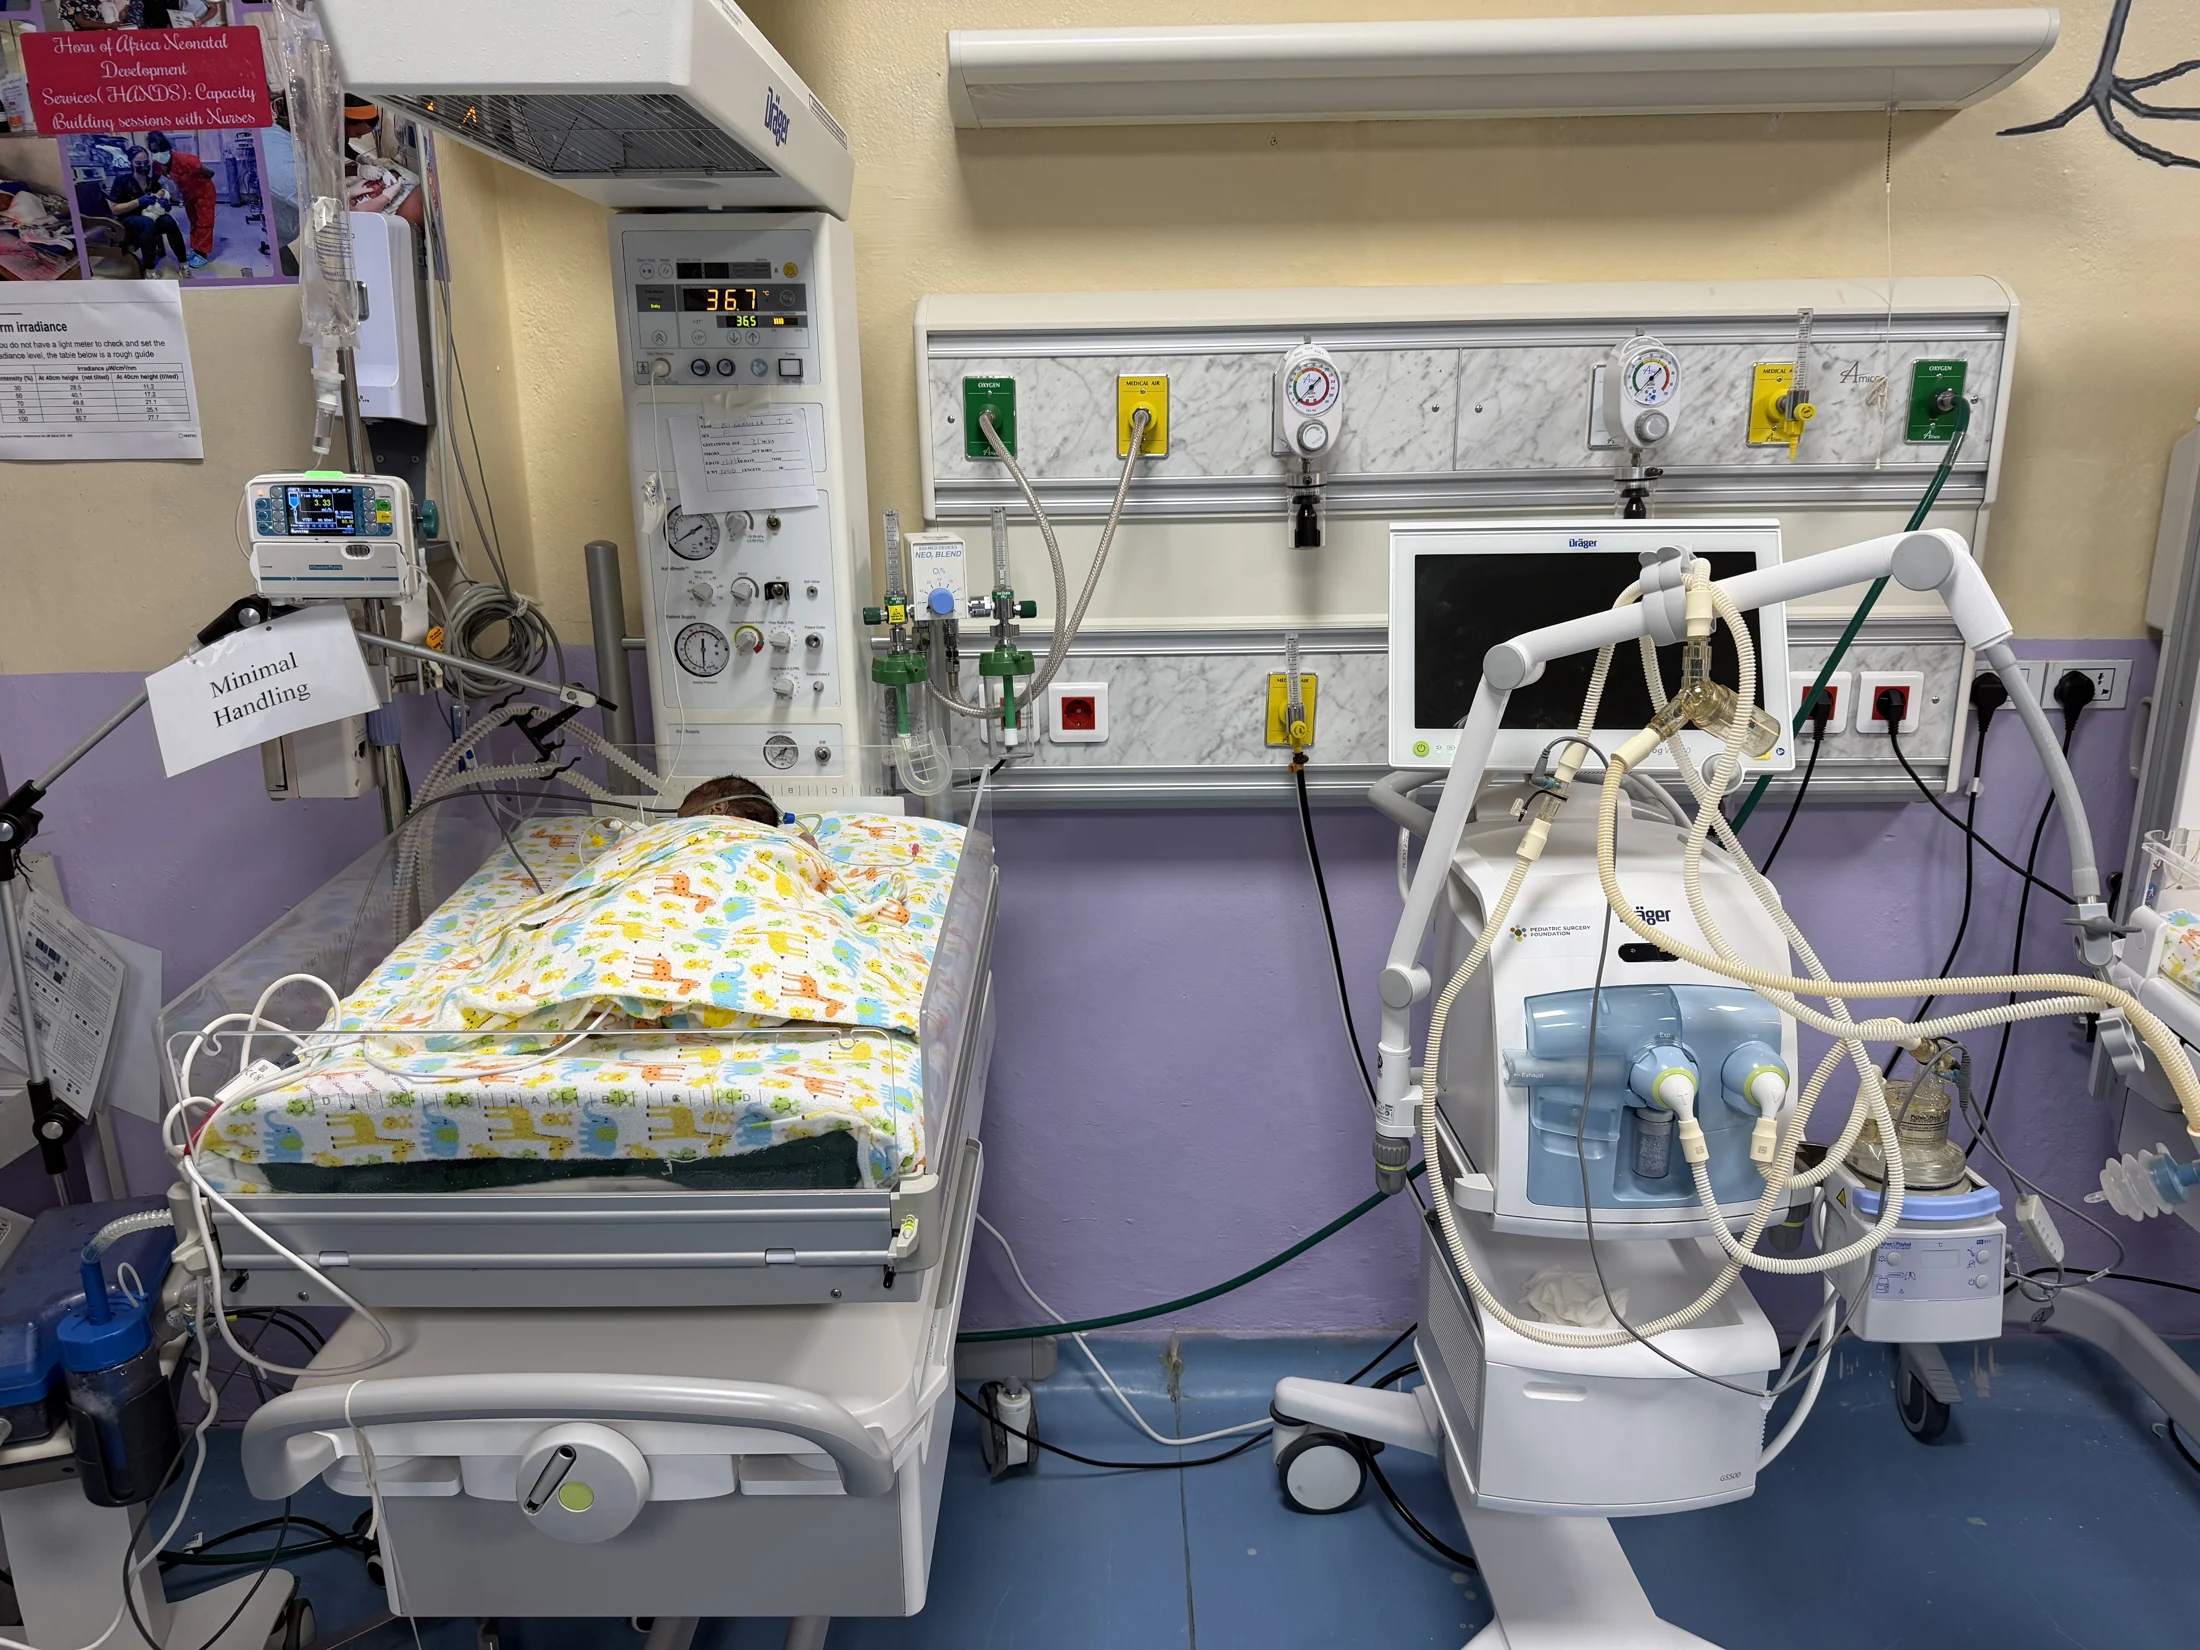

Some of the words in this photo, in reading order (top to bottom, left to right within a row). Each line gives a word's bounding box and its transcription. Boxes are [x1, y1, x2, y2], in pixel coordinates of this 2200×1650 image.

[53, 37, 94, 54] Horn
[100, 38, 111, 56] of
[116, 35, 160, 56] Africa
[164, 33, 228, 51] Neonatal
[100, 60, 188, 80] Development
[195, 83, 256, 104] Capacity
[53, 113, 114, 132] Building
[119, 115, 171, 129] sessions
[175, 110, 204, 126] with
[207, 108, 255, 126] Nurses
[764, 86, 790, 147] Dräger
[707, 289, 756, 311] 36.7
[16, 321, 67, 332] irradiance
[736, 315, 757, 328] 36.5
[9, 341, 19, 349] do
[21, 341, 32, 349] not
[33, 340, 50, 349] have
[58, 340, 73, 350] light
[95, 340, 102, 348] to
[125, 339, 139, 347] and
[153, 339, 165, 347] the
[47, 351, 58, 359] the
[59, 351, 76, 359] table
[78, 350, 97, 359] below
[99, 350, 105, 358] is
[113, 350, 133, 359] rough
[134, 350, 154, 359] guide
[1568, 538, 1598, 549] Dräger
[935, 550, 962, 558] BLEND
[209, 652, 298, 698] Minimal
[213, 683, 311, 728] Handling
[1620, 906, 1671, 925] äger
[100, 955, 117, 972] MTTS
[322, 1096, 331, 1105] D
[391, 1096, 400, 1105] C
[531, 1095, 540, 1104] A
[602, 1095, 610, 1104] B
[743, 1093, 751, 1102] D
[1720, 1471, 1741, 1481] GS500
